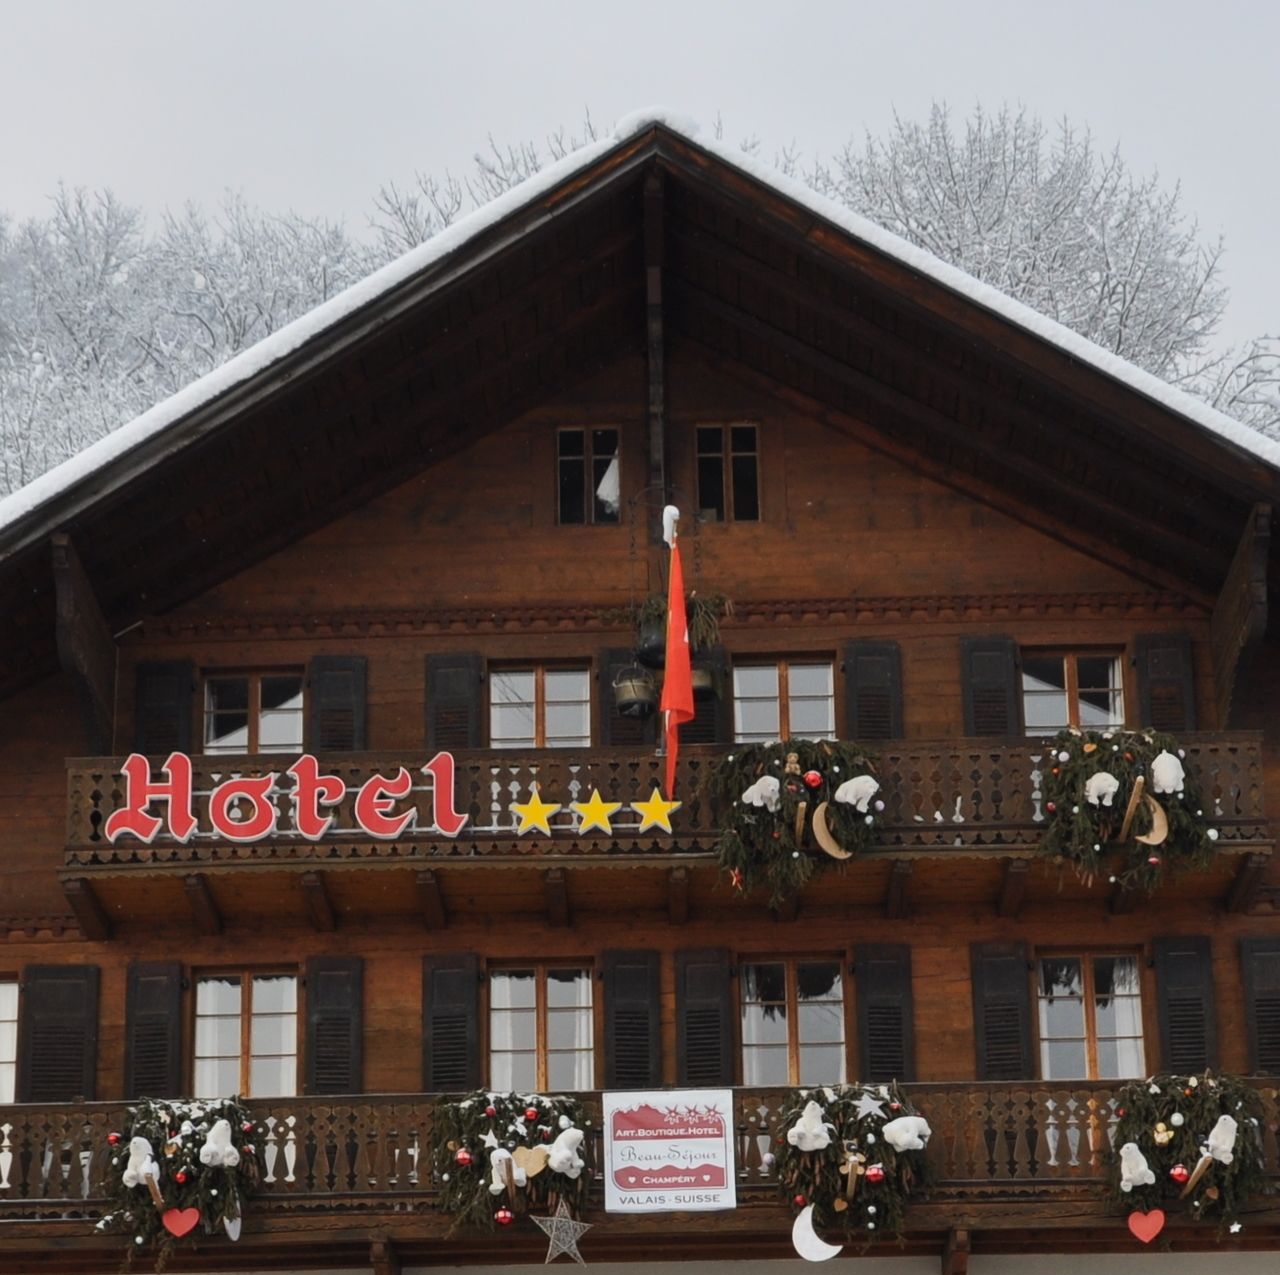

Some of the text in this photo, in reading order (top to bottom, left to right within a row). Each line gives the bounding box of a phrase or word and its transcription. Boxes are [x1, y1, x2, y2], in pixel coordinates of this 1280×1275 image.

[105, 751, 470, 844] Hotel
[620, 1144, 717, 1164] Beau-Séjour
[619, 1195, 666, 1205] VALAIS
[674, 1194, 721, 1204] SUISSE
